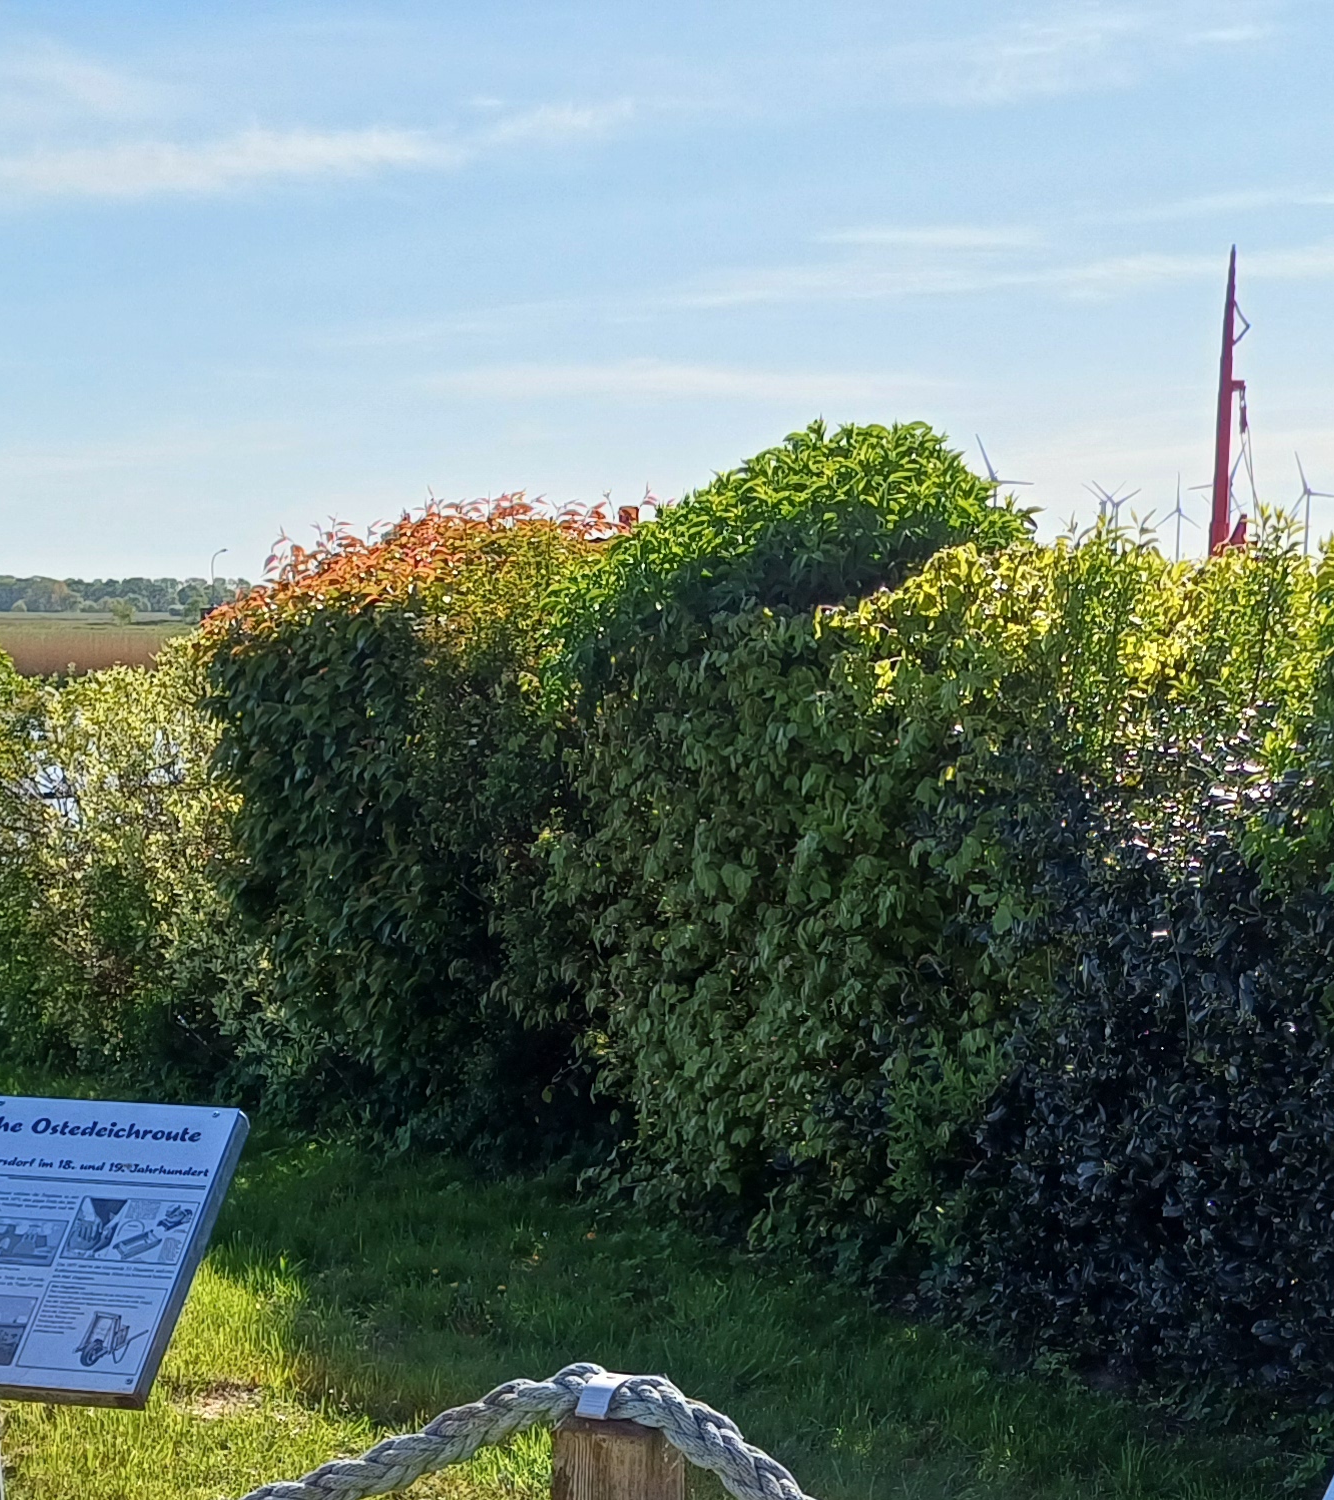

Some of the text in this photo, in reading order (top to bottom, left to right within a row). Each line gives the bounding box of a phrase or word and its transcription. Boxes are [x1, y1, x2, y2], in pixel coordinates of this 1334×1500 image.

[31, 1117, 202, 1143] Ostedeichroute
[38, 1159, 53, 1169] im
[58, 1159, 76, 1170] 18.
[79, 1161, 106, 1173] und
[108, 1162, 126, 1174] 19.
[130, 1163, 209, 1177] Jahrhundert
